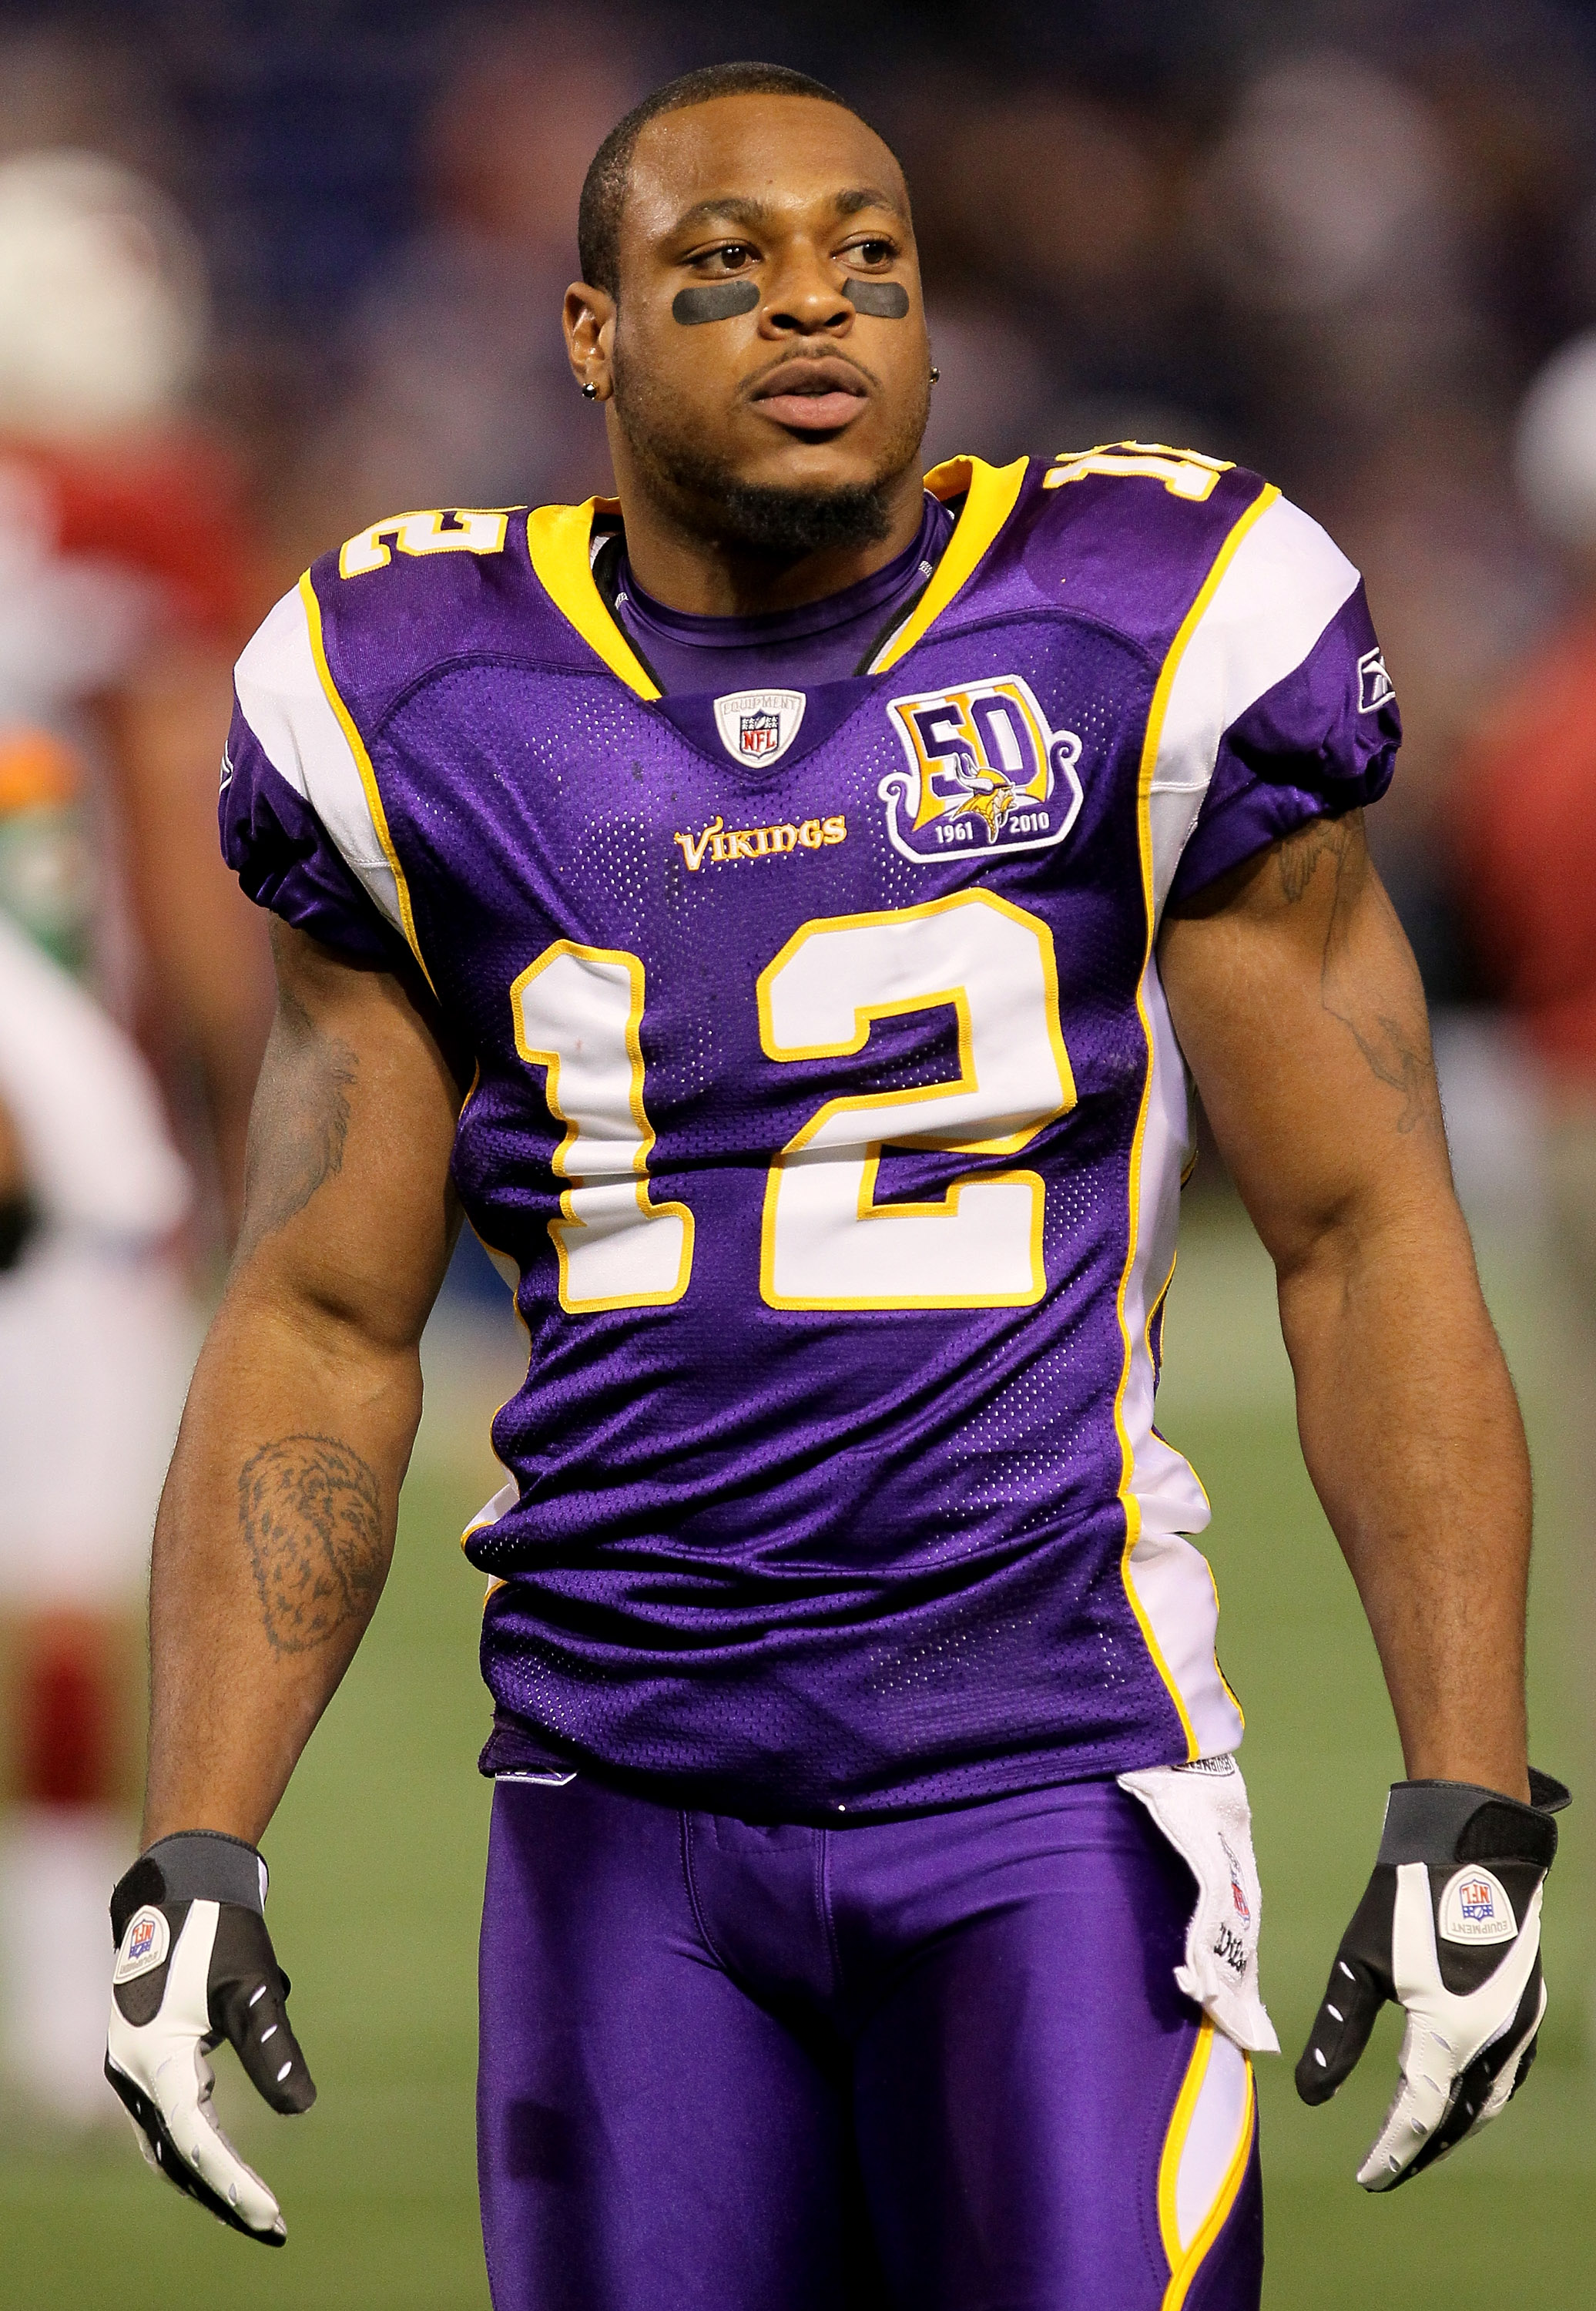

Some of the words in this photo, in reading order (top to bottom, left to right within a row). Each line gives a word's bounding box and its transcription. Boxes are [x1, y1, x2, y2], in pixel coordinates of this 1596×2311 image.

[723, 696, 798, 715] EQUIPMENT
[743, 730, 776, 753] NFL
[911, 691, 1040, 799] 50
[935, 820, 974, 844] 1961
[1010, 811, 1051, 834] 2010
[510, 887, 1078, 1314] 12
[1461, 1883, 1490, 1905] NFL
[1452, 1920, 1508, 1934] EQUIPMENT
